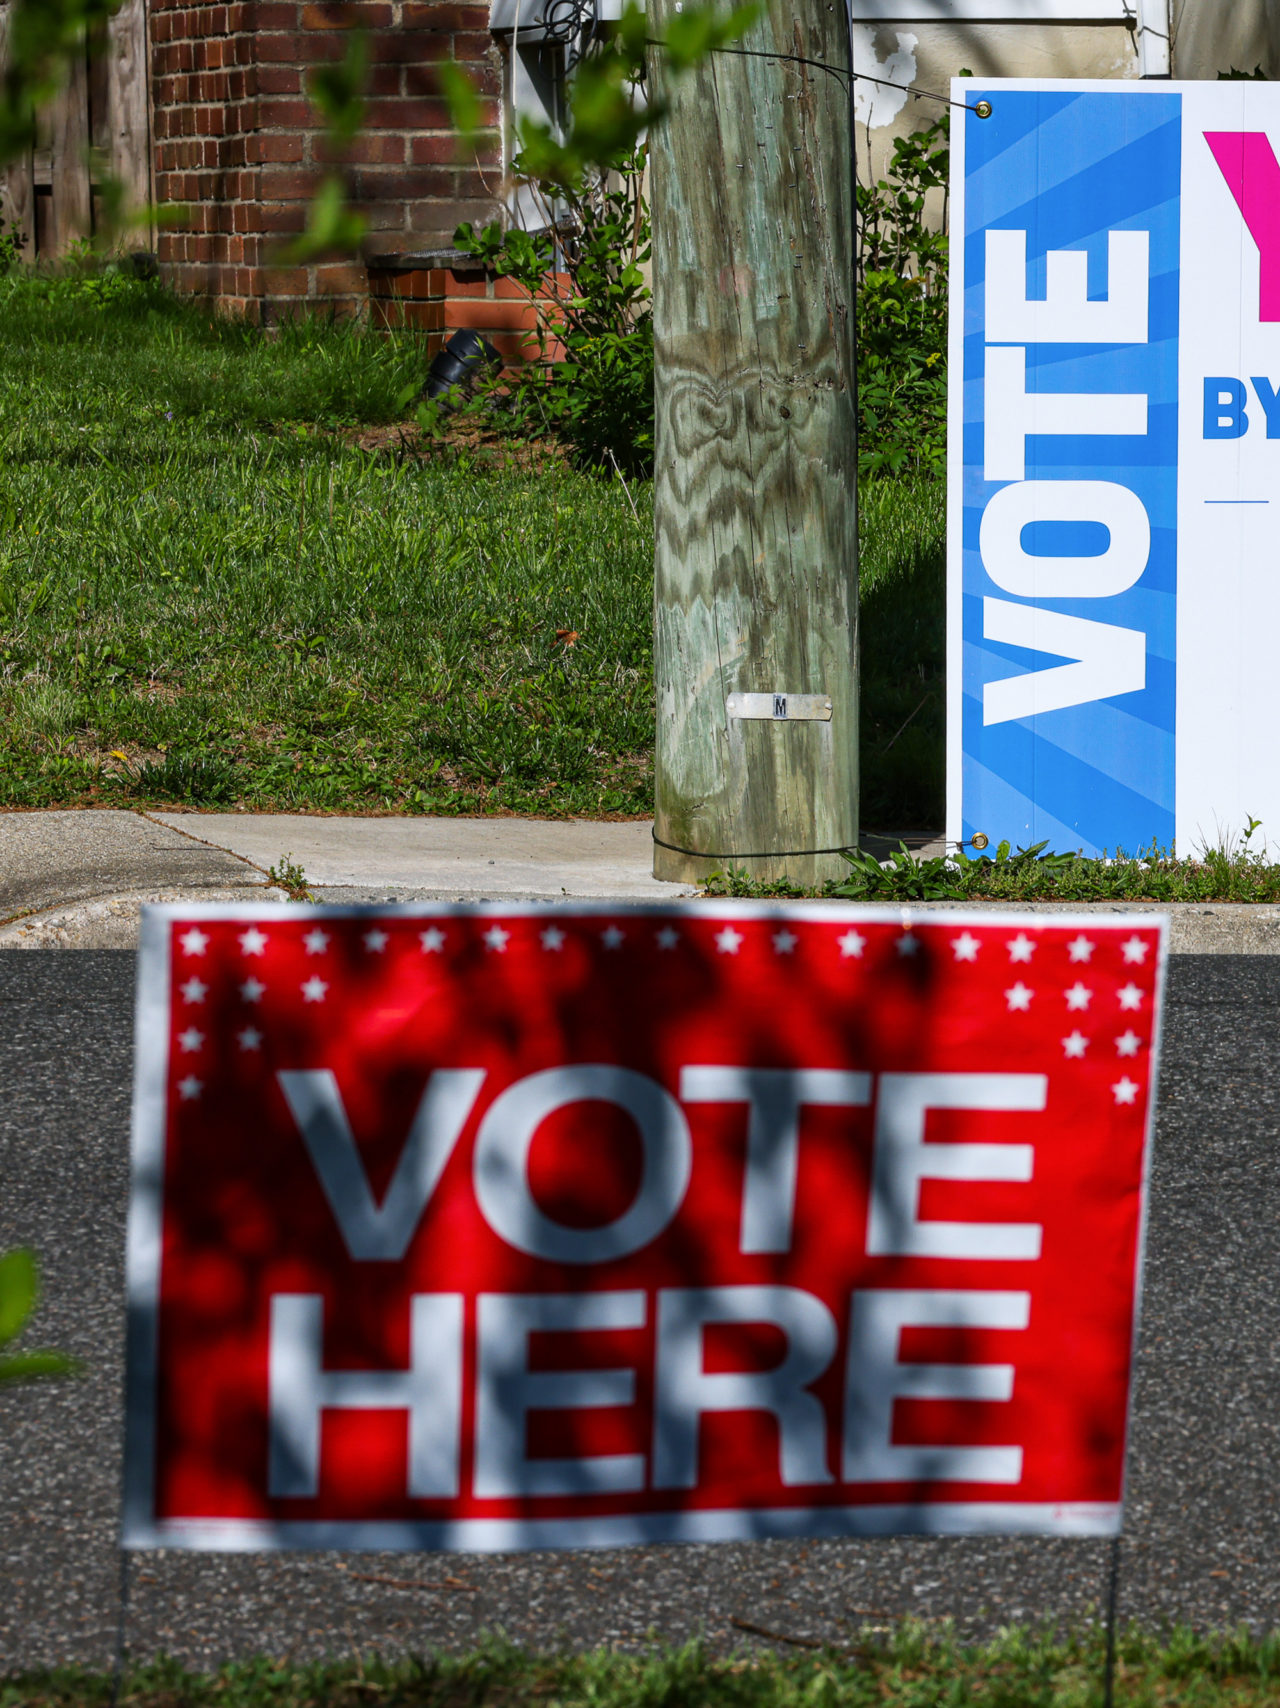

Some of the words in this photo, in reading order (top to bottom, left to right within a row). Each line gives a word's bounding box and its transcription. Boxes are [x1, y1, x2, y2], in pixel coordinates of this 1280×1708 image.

[980, 229, 1151, 727] VOTE
[775, 698, 786, 715] M
[276, 1063, 1049, 1266] VOTE
[267, 1285, 1032, 1499] HERE
